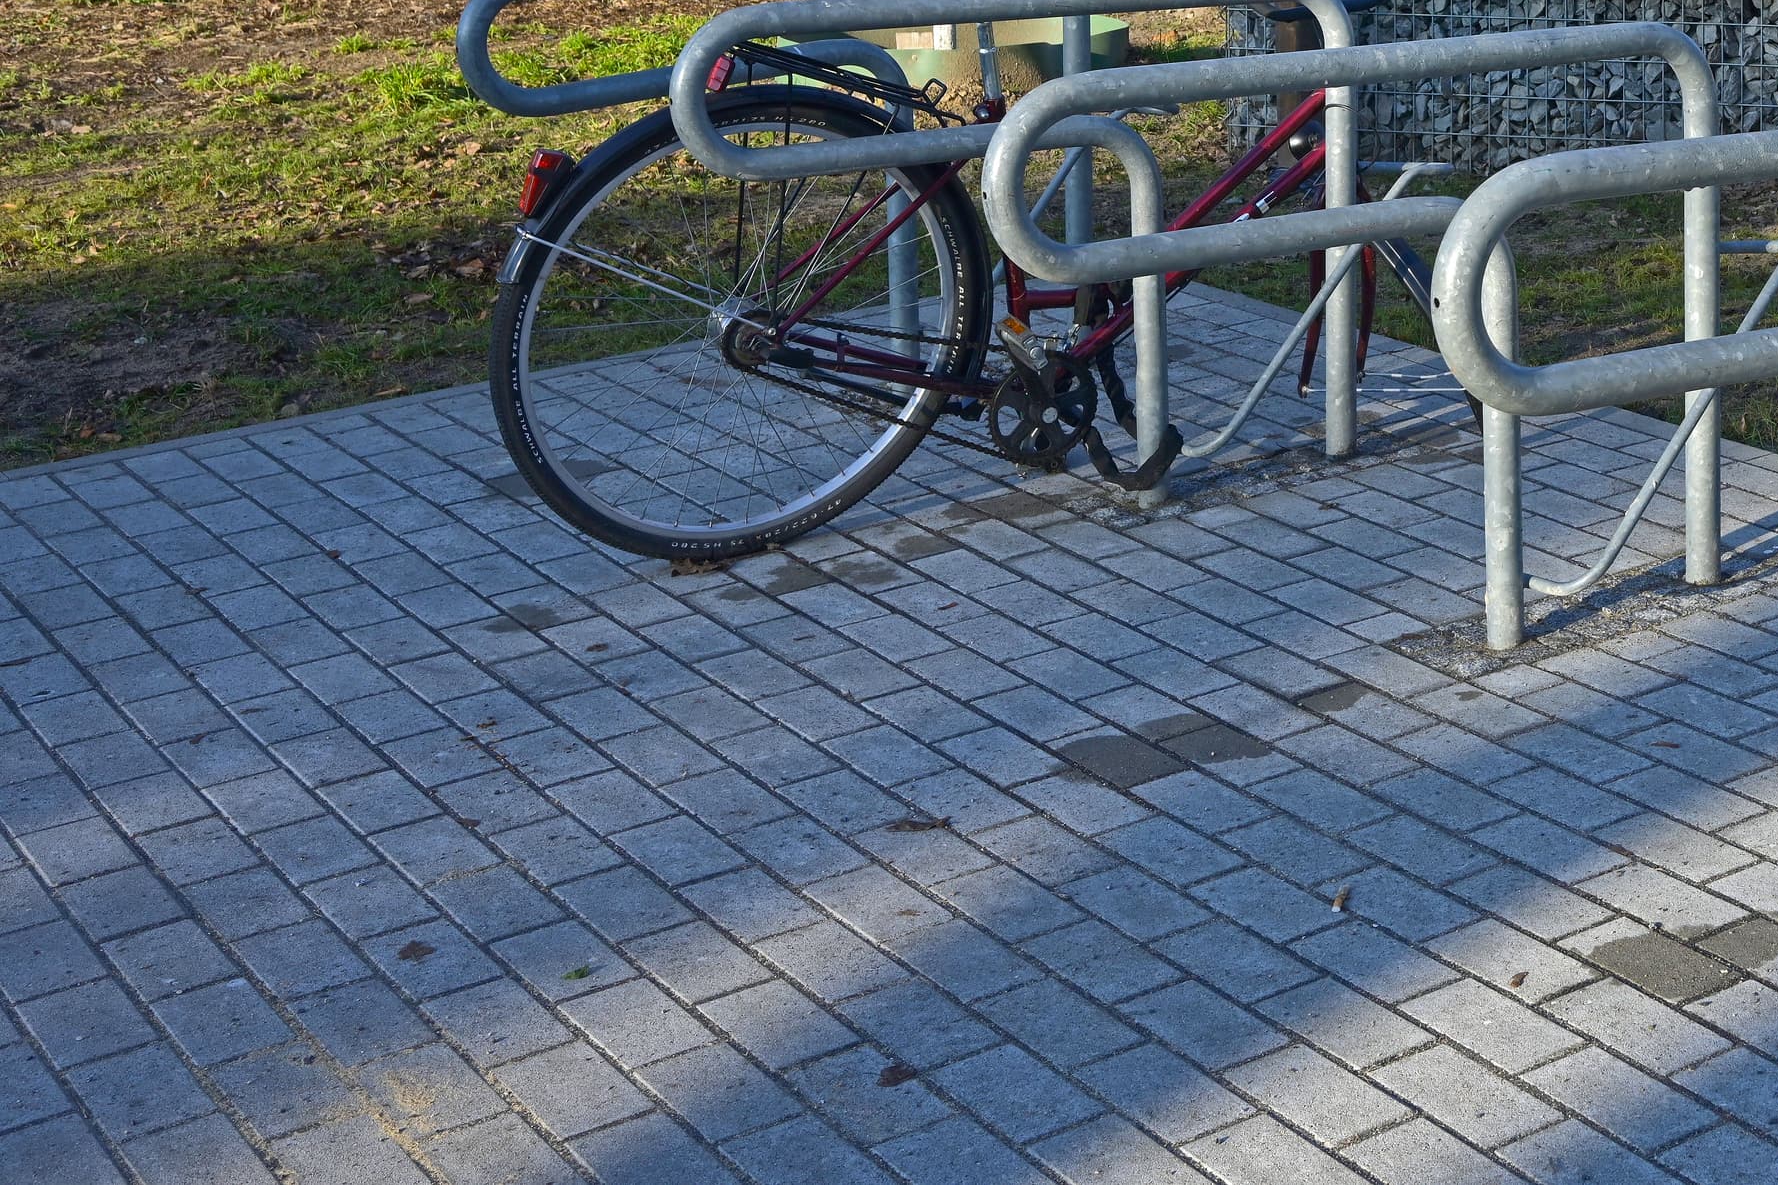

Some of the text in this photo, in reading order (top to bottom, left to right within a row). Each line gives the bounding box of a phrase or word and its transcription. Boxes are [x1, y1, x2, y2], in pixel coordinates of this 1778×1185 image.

[512, 294, 528, 358] TERRAIN
[958, 286, 966, 308] ALL
[516, 400, 543, 464] SCHWALBE
